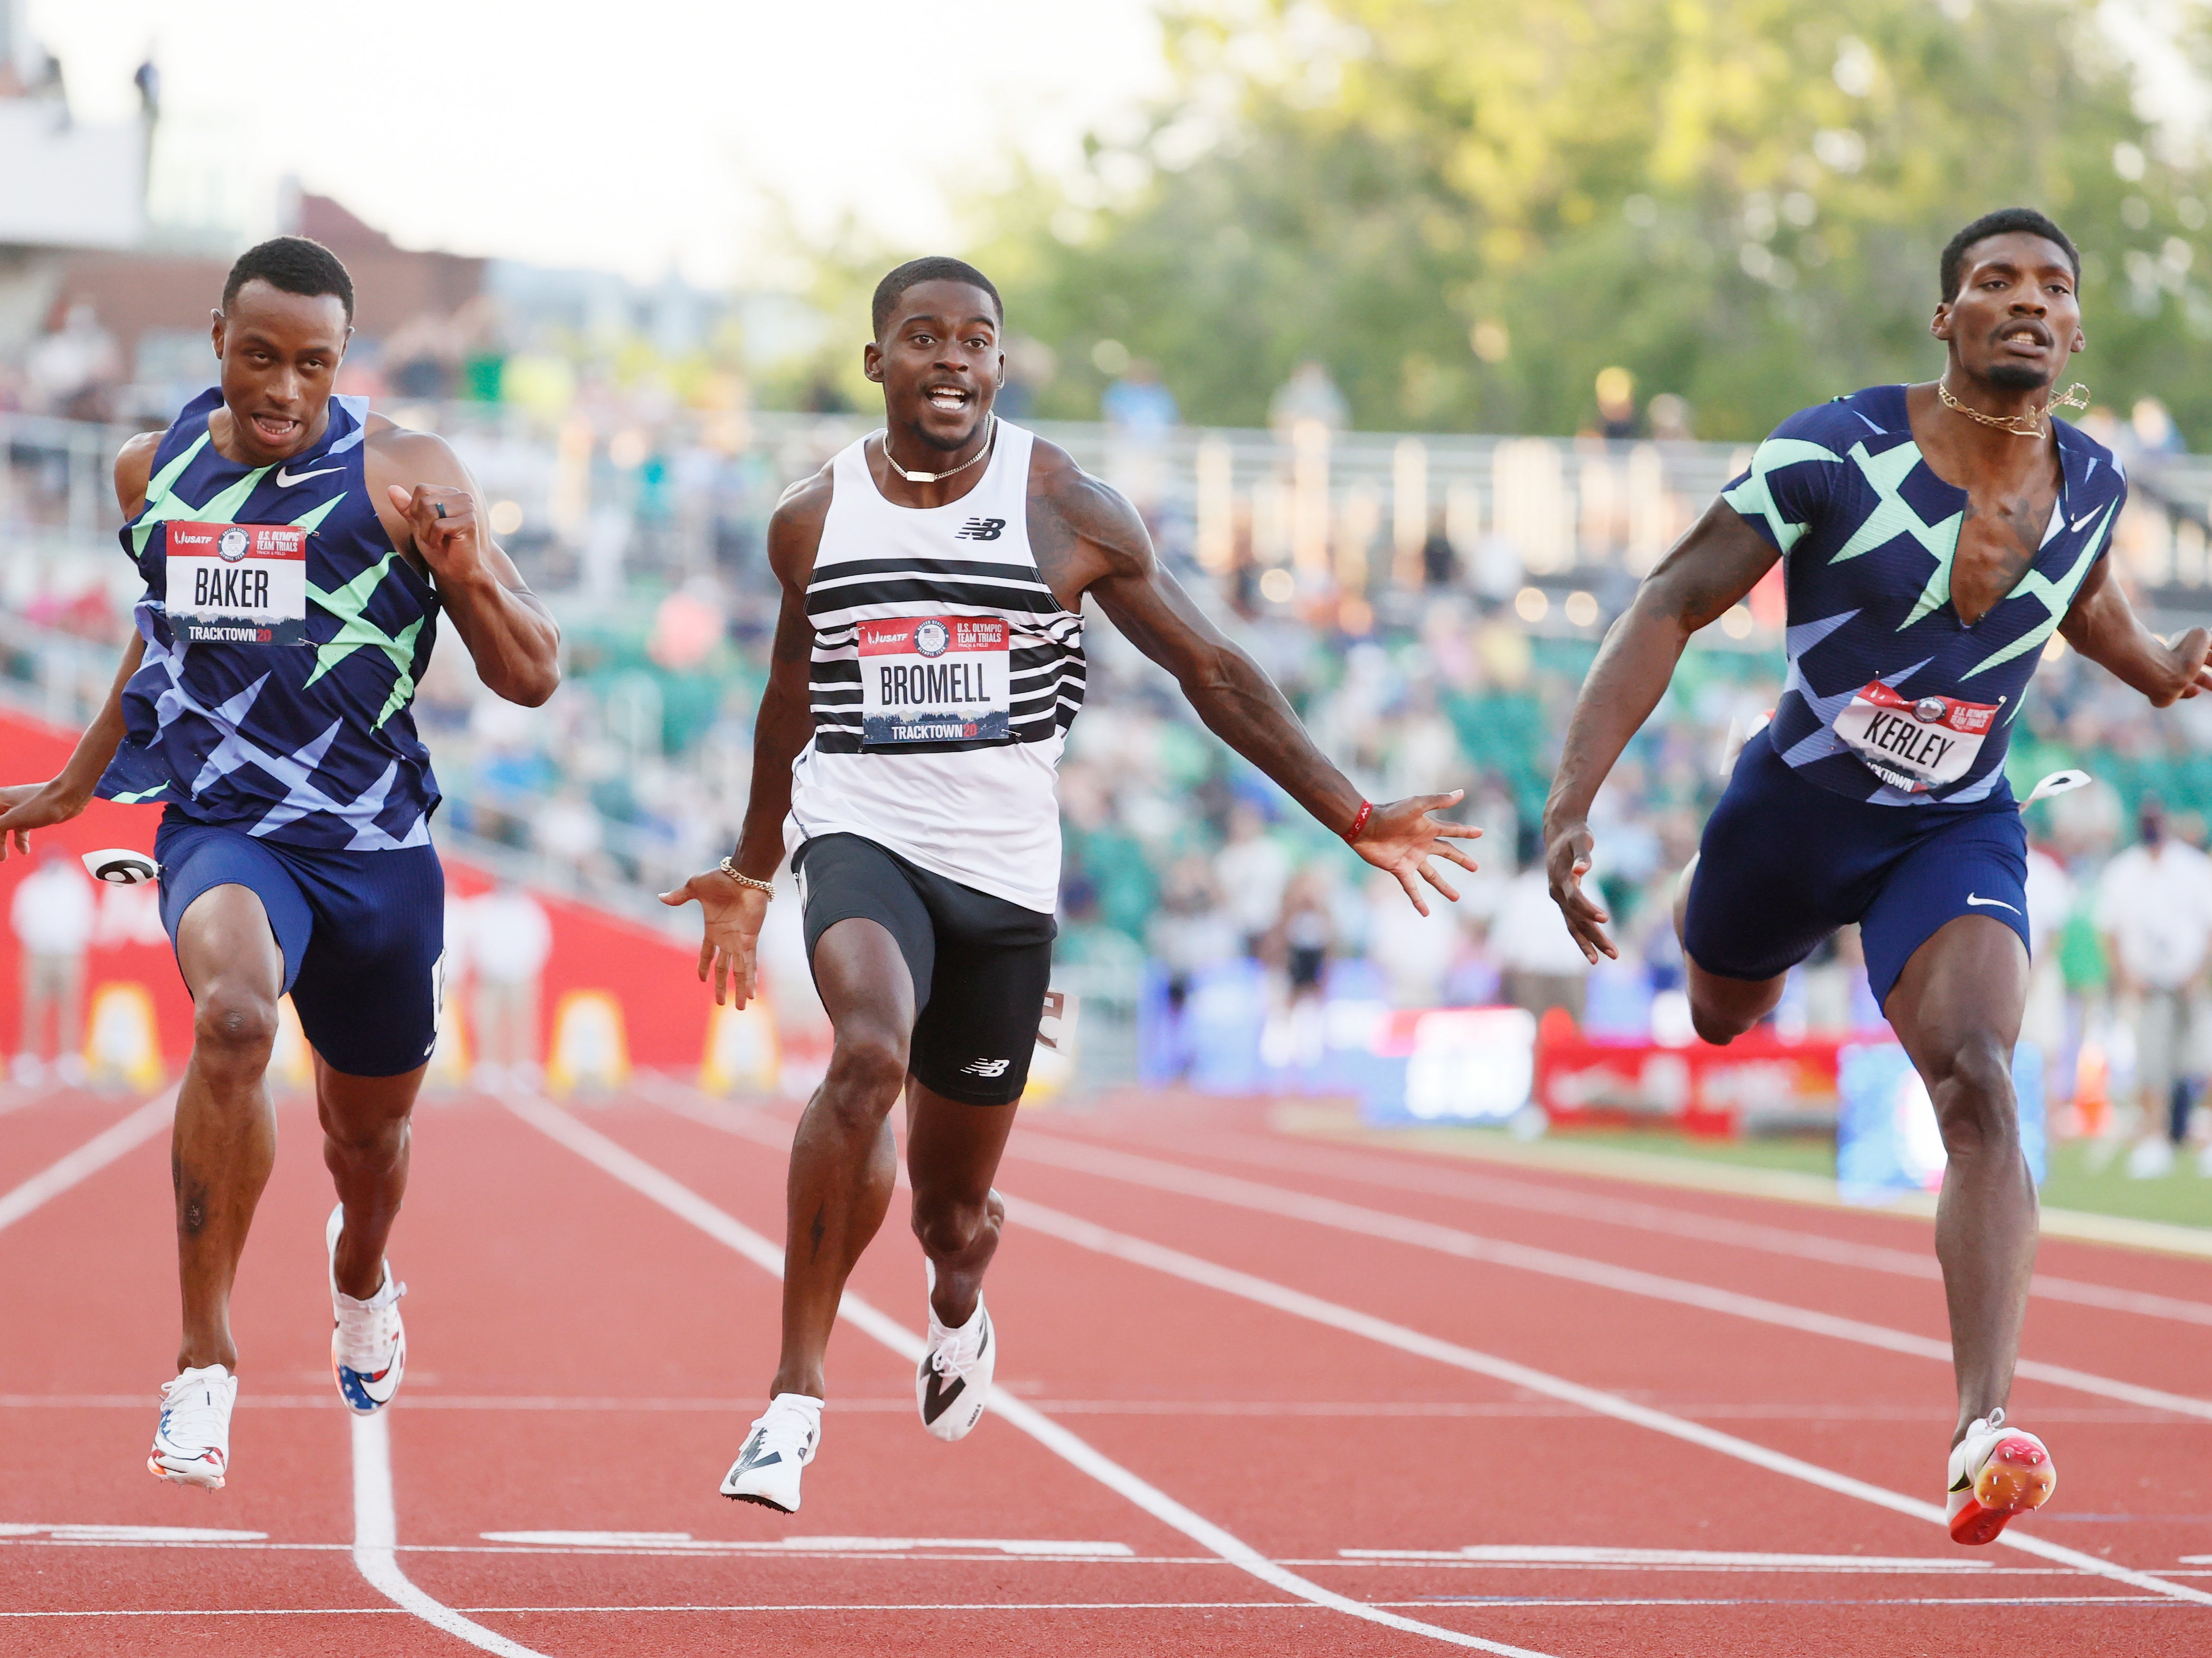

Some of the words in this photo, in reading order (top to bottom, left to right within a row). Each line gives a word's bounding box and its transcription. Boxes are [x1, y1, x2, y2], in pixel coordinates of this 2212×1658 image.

[258, 530, 270, 540] U.S.
[271, 531, 299, 542] OLYMPIC
[257, 540, 274, 550] TEAM
[275, 541, 298, 552] TRIALS
[195, 568, 268, 608] BAKER
[917, 620, 931, 631] UNITED
[932, 620, 946, 630] STATES
[957, 623, 970, 633] U.S.
[972, 623, 1002, 633] OLYMPIC
[879, 633, 908, 643] USATF
[957, 633, 976, 643] TEAM
[978, 633, 1002, 643] TRIALS
[918, 646, 934, 656] OLYMPIC
[936, 646, 946, 655] TEAM
[880, 663, 990, 706] BROMELL
[1863, 711, 1955, 768] KERLEY
